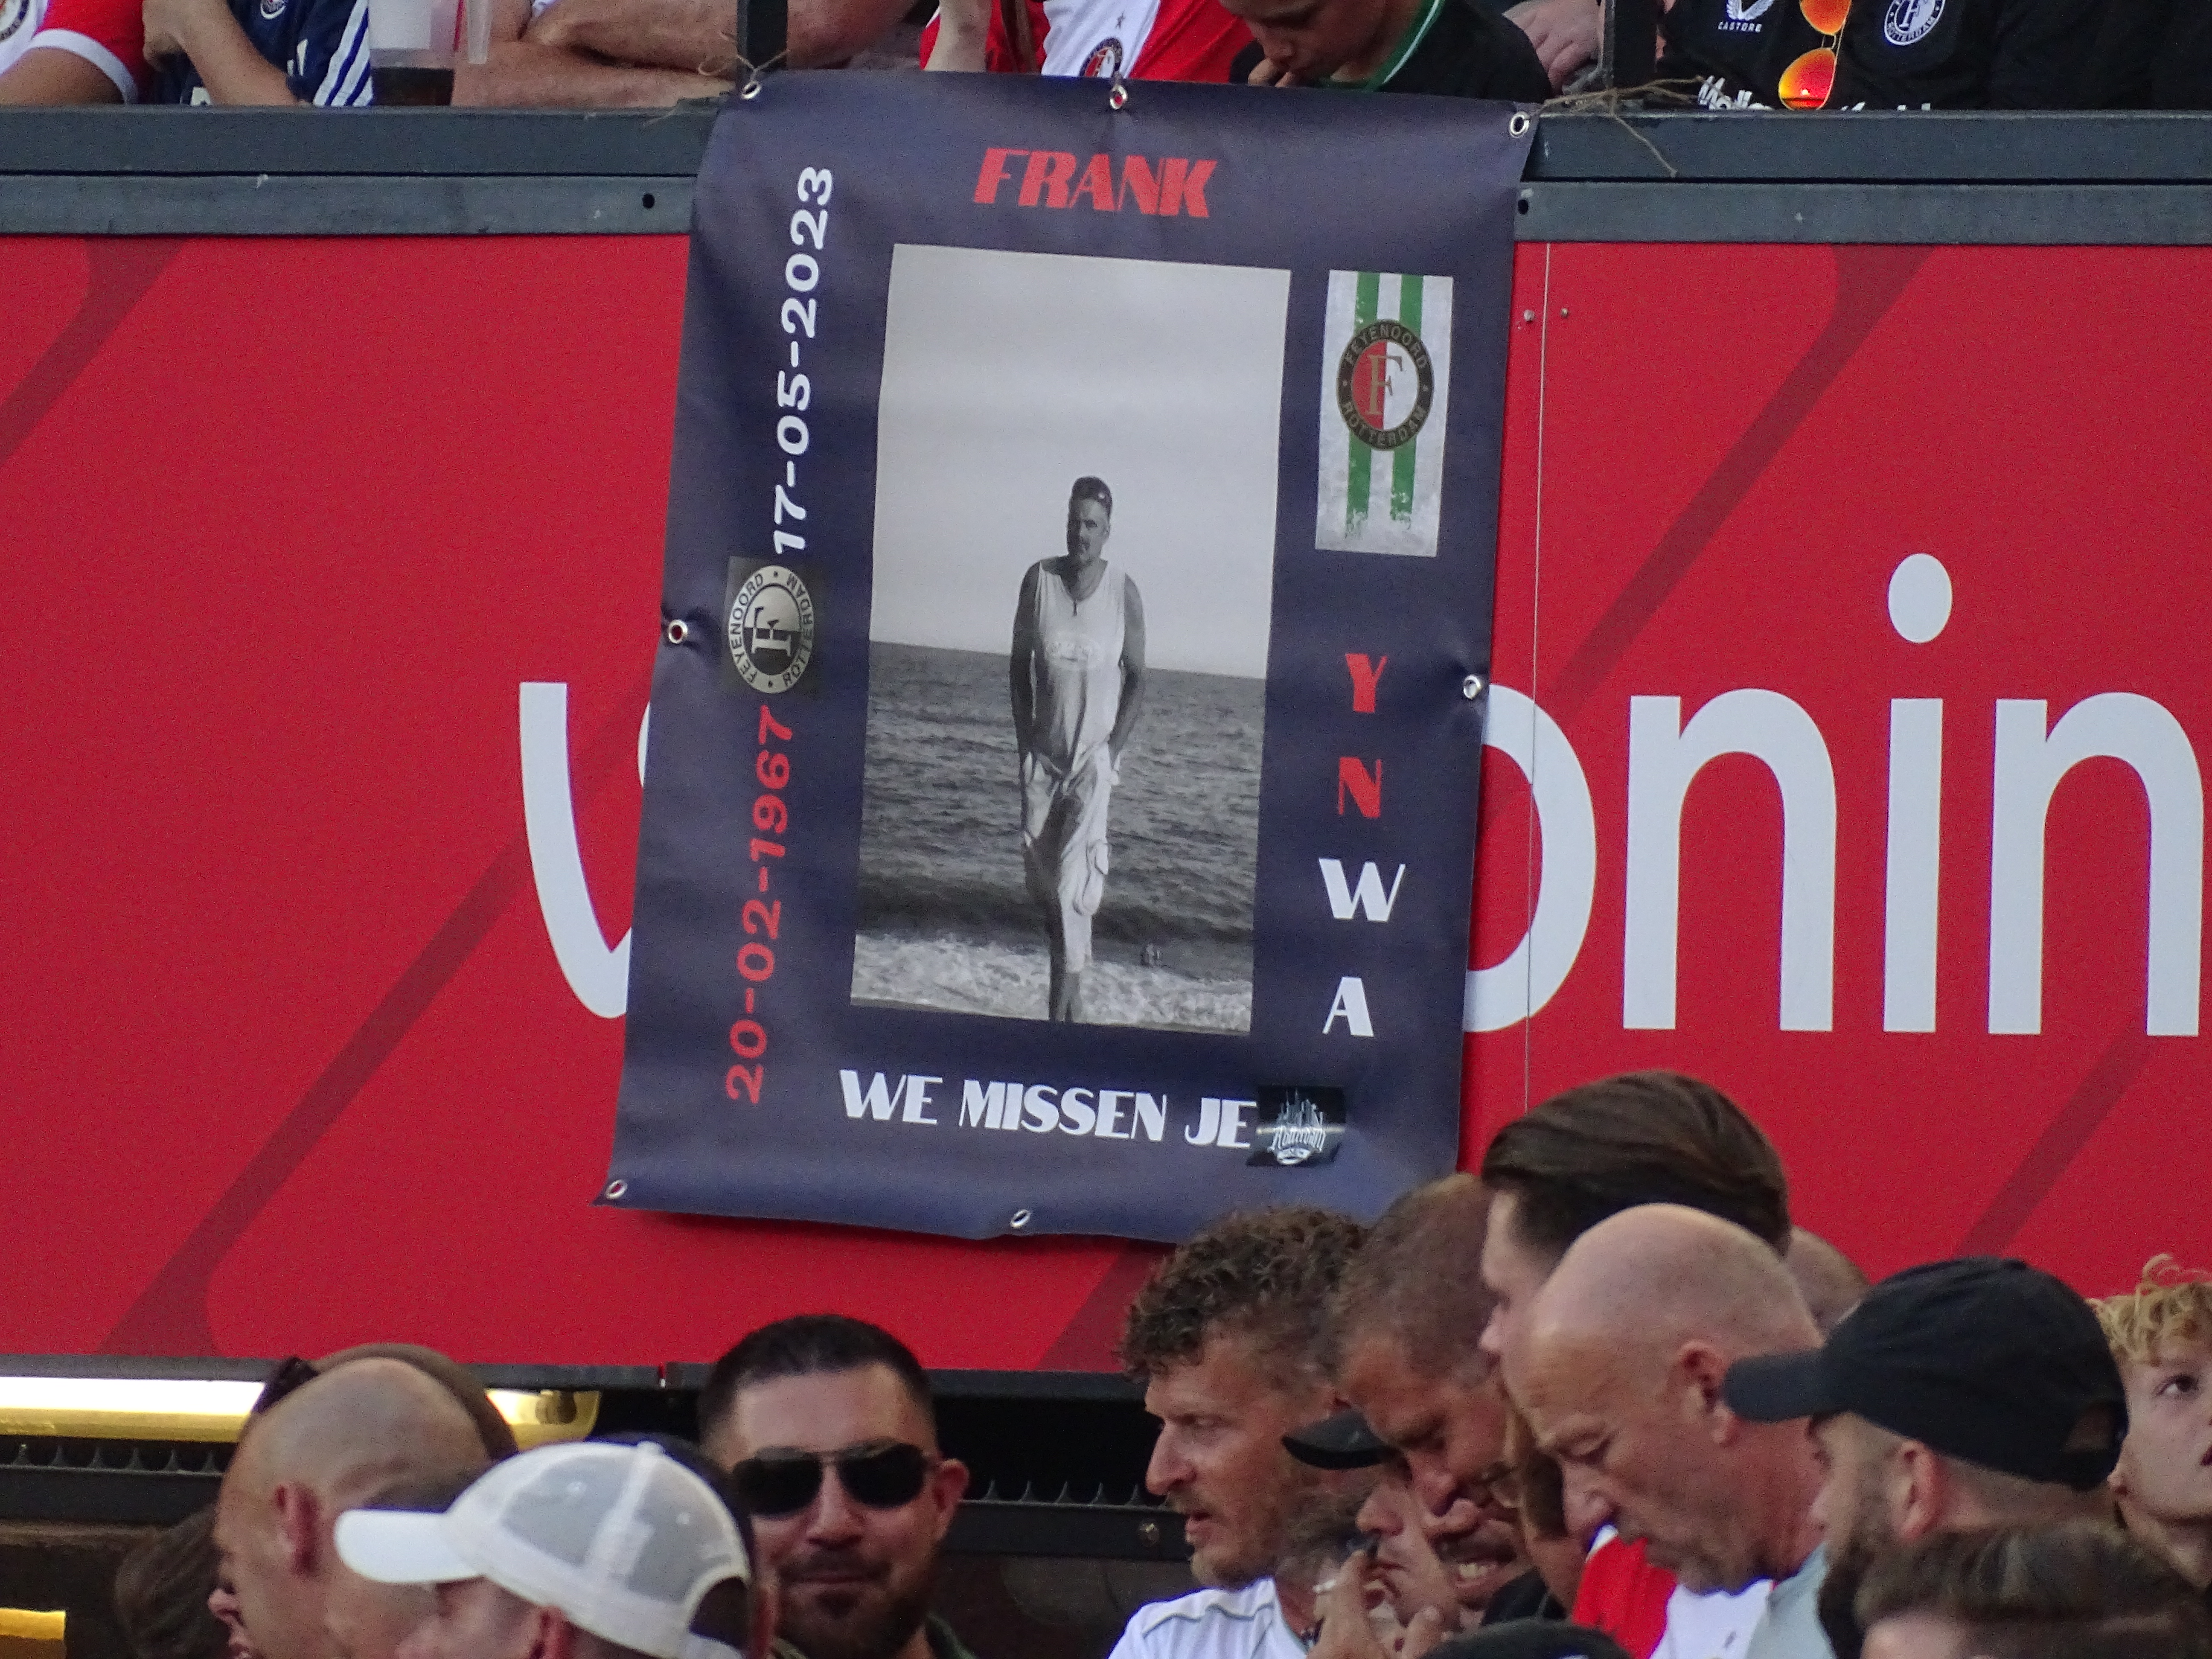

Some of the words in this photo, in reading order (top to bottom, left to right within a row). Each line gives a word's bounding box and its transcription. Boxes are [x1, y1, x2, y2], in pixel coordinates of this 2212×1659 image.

[1718, 21, 1763, 33] CASTORE
[973, 147, 1218, 218] FRANK
[773, 166, 833, 555] 17-05-2023
[1344, 323, 1427, 365] FEYENOORD
[730, 573, 764, 684] FEYENOORD
[725, 704, 793, 1104] 20-02-1967
[839, 1069, 943, 1125] WE
[959, 1079, 1167, 1142] MISSEN
[1184, 1097, 1257, 1149] JE
